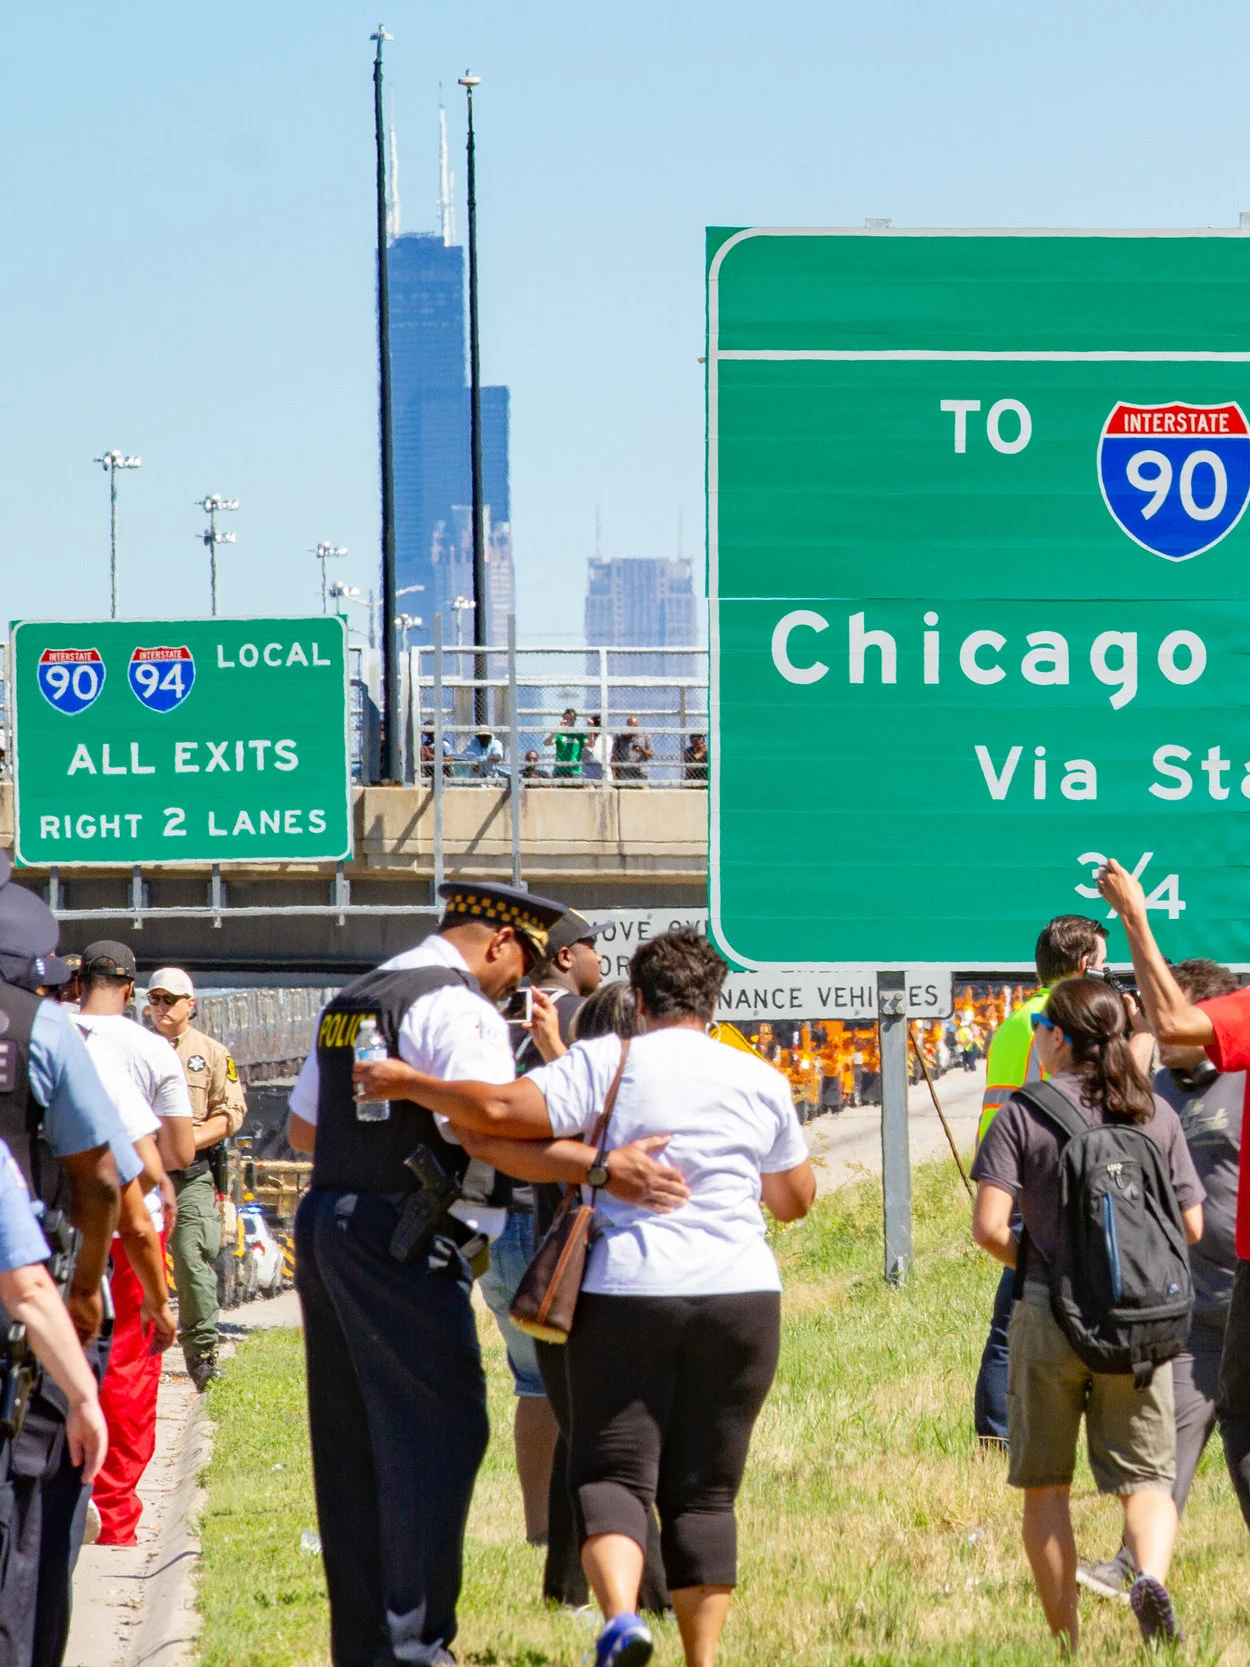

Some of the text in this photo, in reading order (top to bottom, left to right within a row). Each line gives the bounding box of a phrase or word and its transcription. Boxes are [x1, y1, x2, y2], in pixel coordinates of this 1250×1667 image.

[940, 399, 1032, 454] TO
[1124, 413, 1230, 433] INTERSTATE
[1126, 449, 1228, 522] 90
[49, 651, 93, 662] INTERSTATE
[139, 649, 182, 660] INTERSTATE
[217, 642, 331, 668] LOCAL
[771, 610, 1206, 710] Chicago
[46, 665, 99, 700] 90
[135, 663, 185, 699] 94
[67, 740, 299, 775] ALL EXITS
[975, 745, 1097, 800] Via
[40, 807, 327, 839] RIGHT 2 LANES
[818, 985, 938, 1008] VEHIES
[318, 1013, 377, 1047] POLIC
